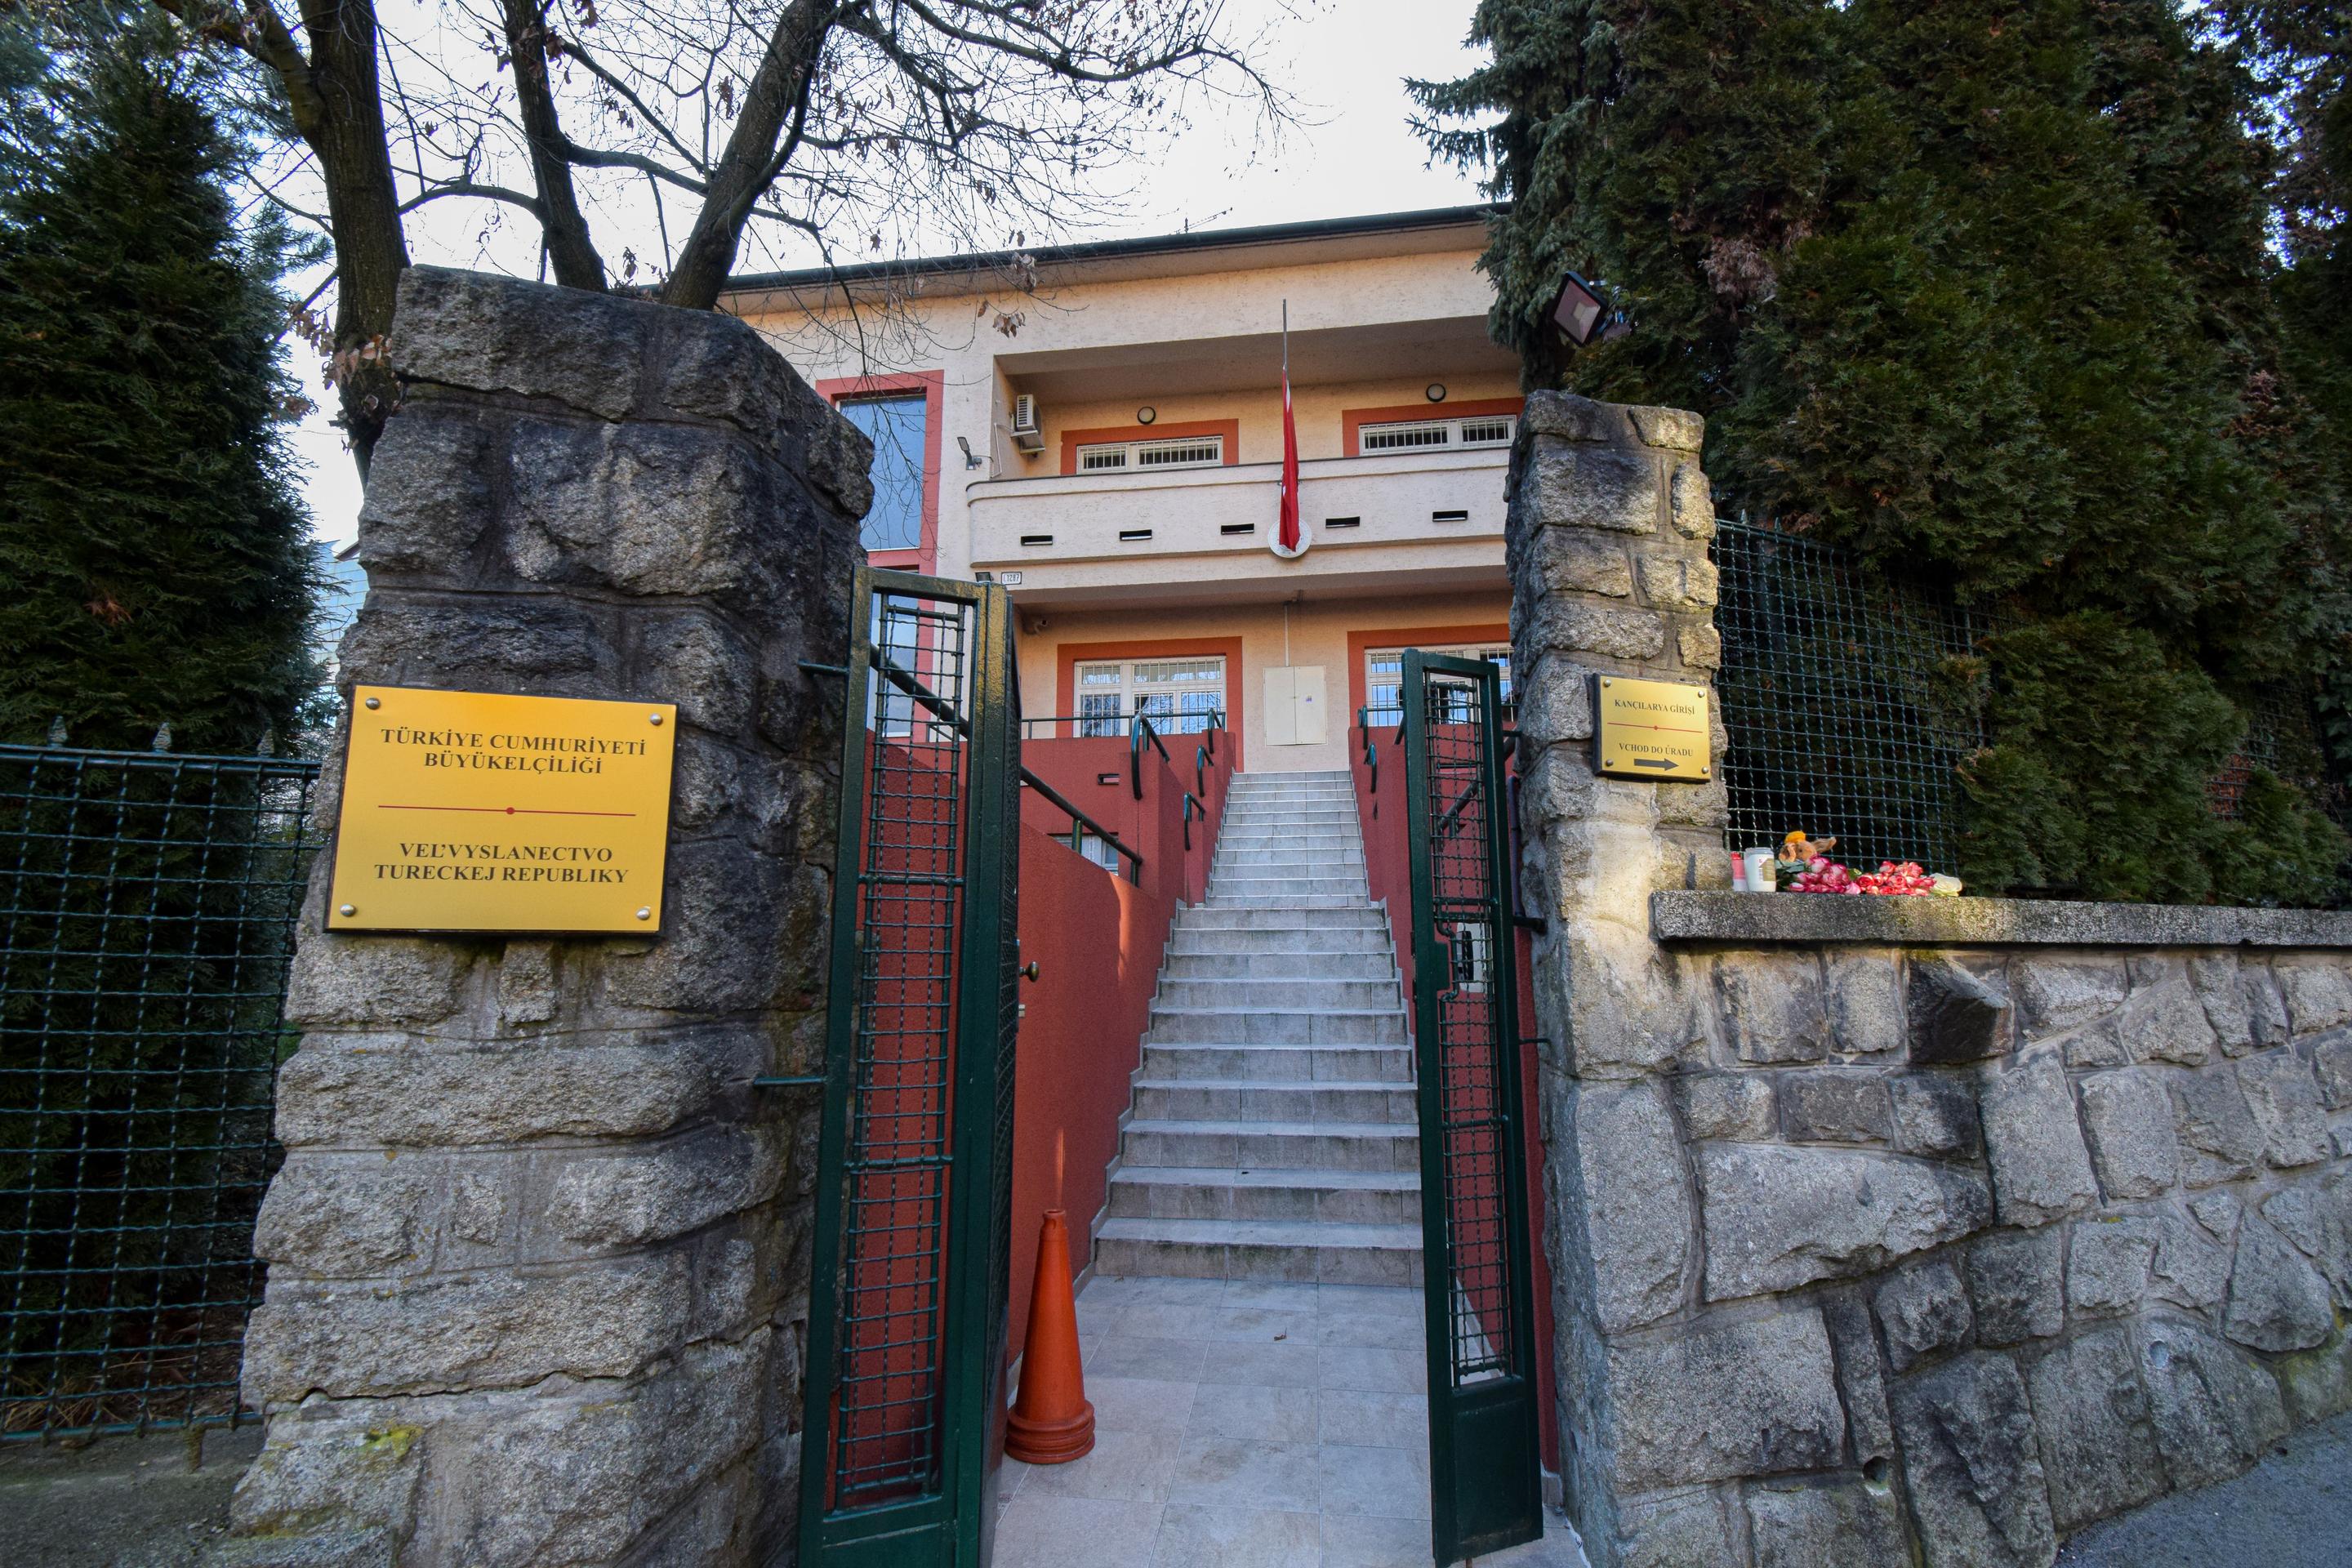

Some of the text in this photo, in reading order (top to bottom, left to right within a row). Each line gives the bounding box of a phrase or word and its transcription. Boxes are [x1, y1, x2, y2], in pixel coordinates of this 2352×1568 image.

[1614, 699, 1695, 716] KANÇILARYA GİRİŞİ
[381, 726, 647, 755] TÜRKİYE CUMHURİYETİ
[1619, 742, 1693, 757] VCHOD DO ÚRADU
[424, 751, 603, 775] BÜYÜKELÇİLİĞİ
[374, 864, 630, 884] TURECKEJ REPUBLIKY
